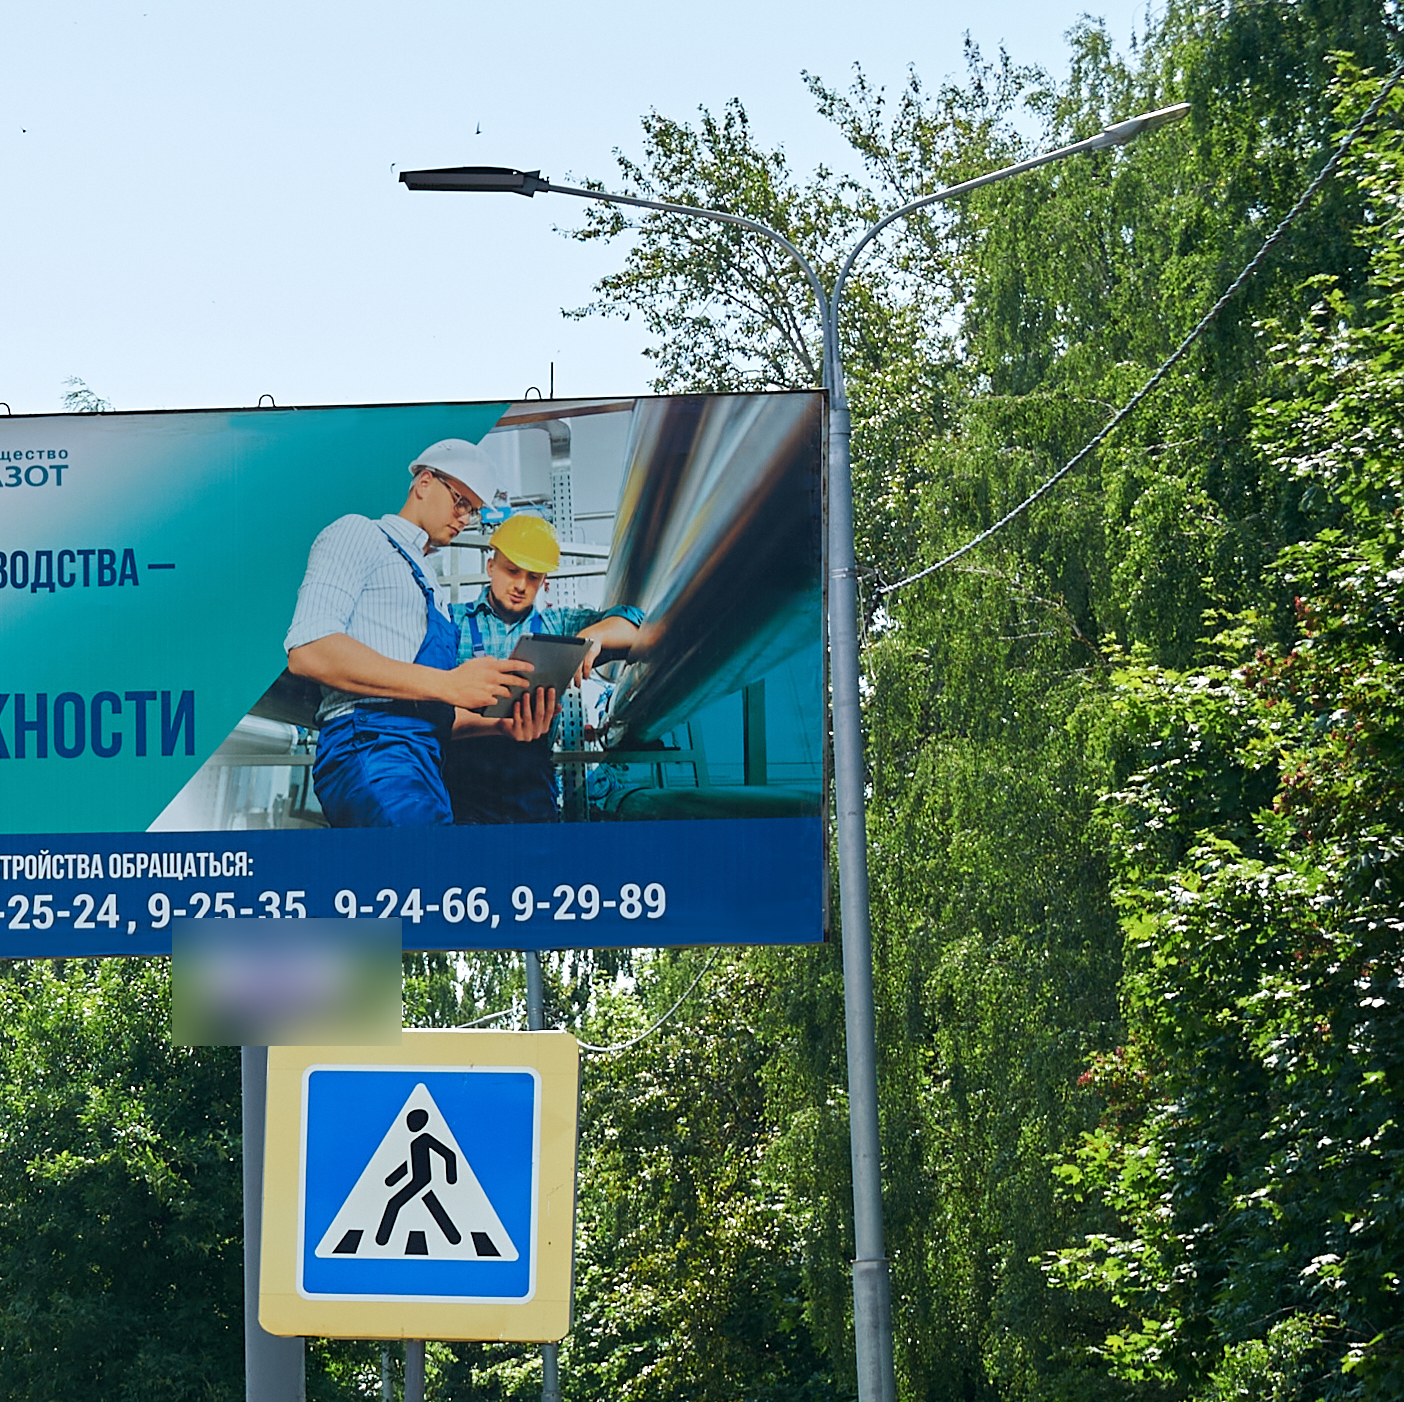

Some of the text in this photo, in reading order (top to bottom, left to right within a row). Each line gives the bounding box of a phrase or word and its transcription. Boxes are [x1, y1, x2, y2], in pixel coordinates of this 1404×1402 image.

[108, 851, 254, 881] ОБРАЩАТЬСЯ:
[334, 886, 500, 928] 9-24-66,
[511, 884, 666, 922] 9-29-89
